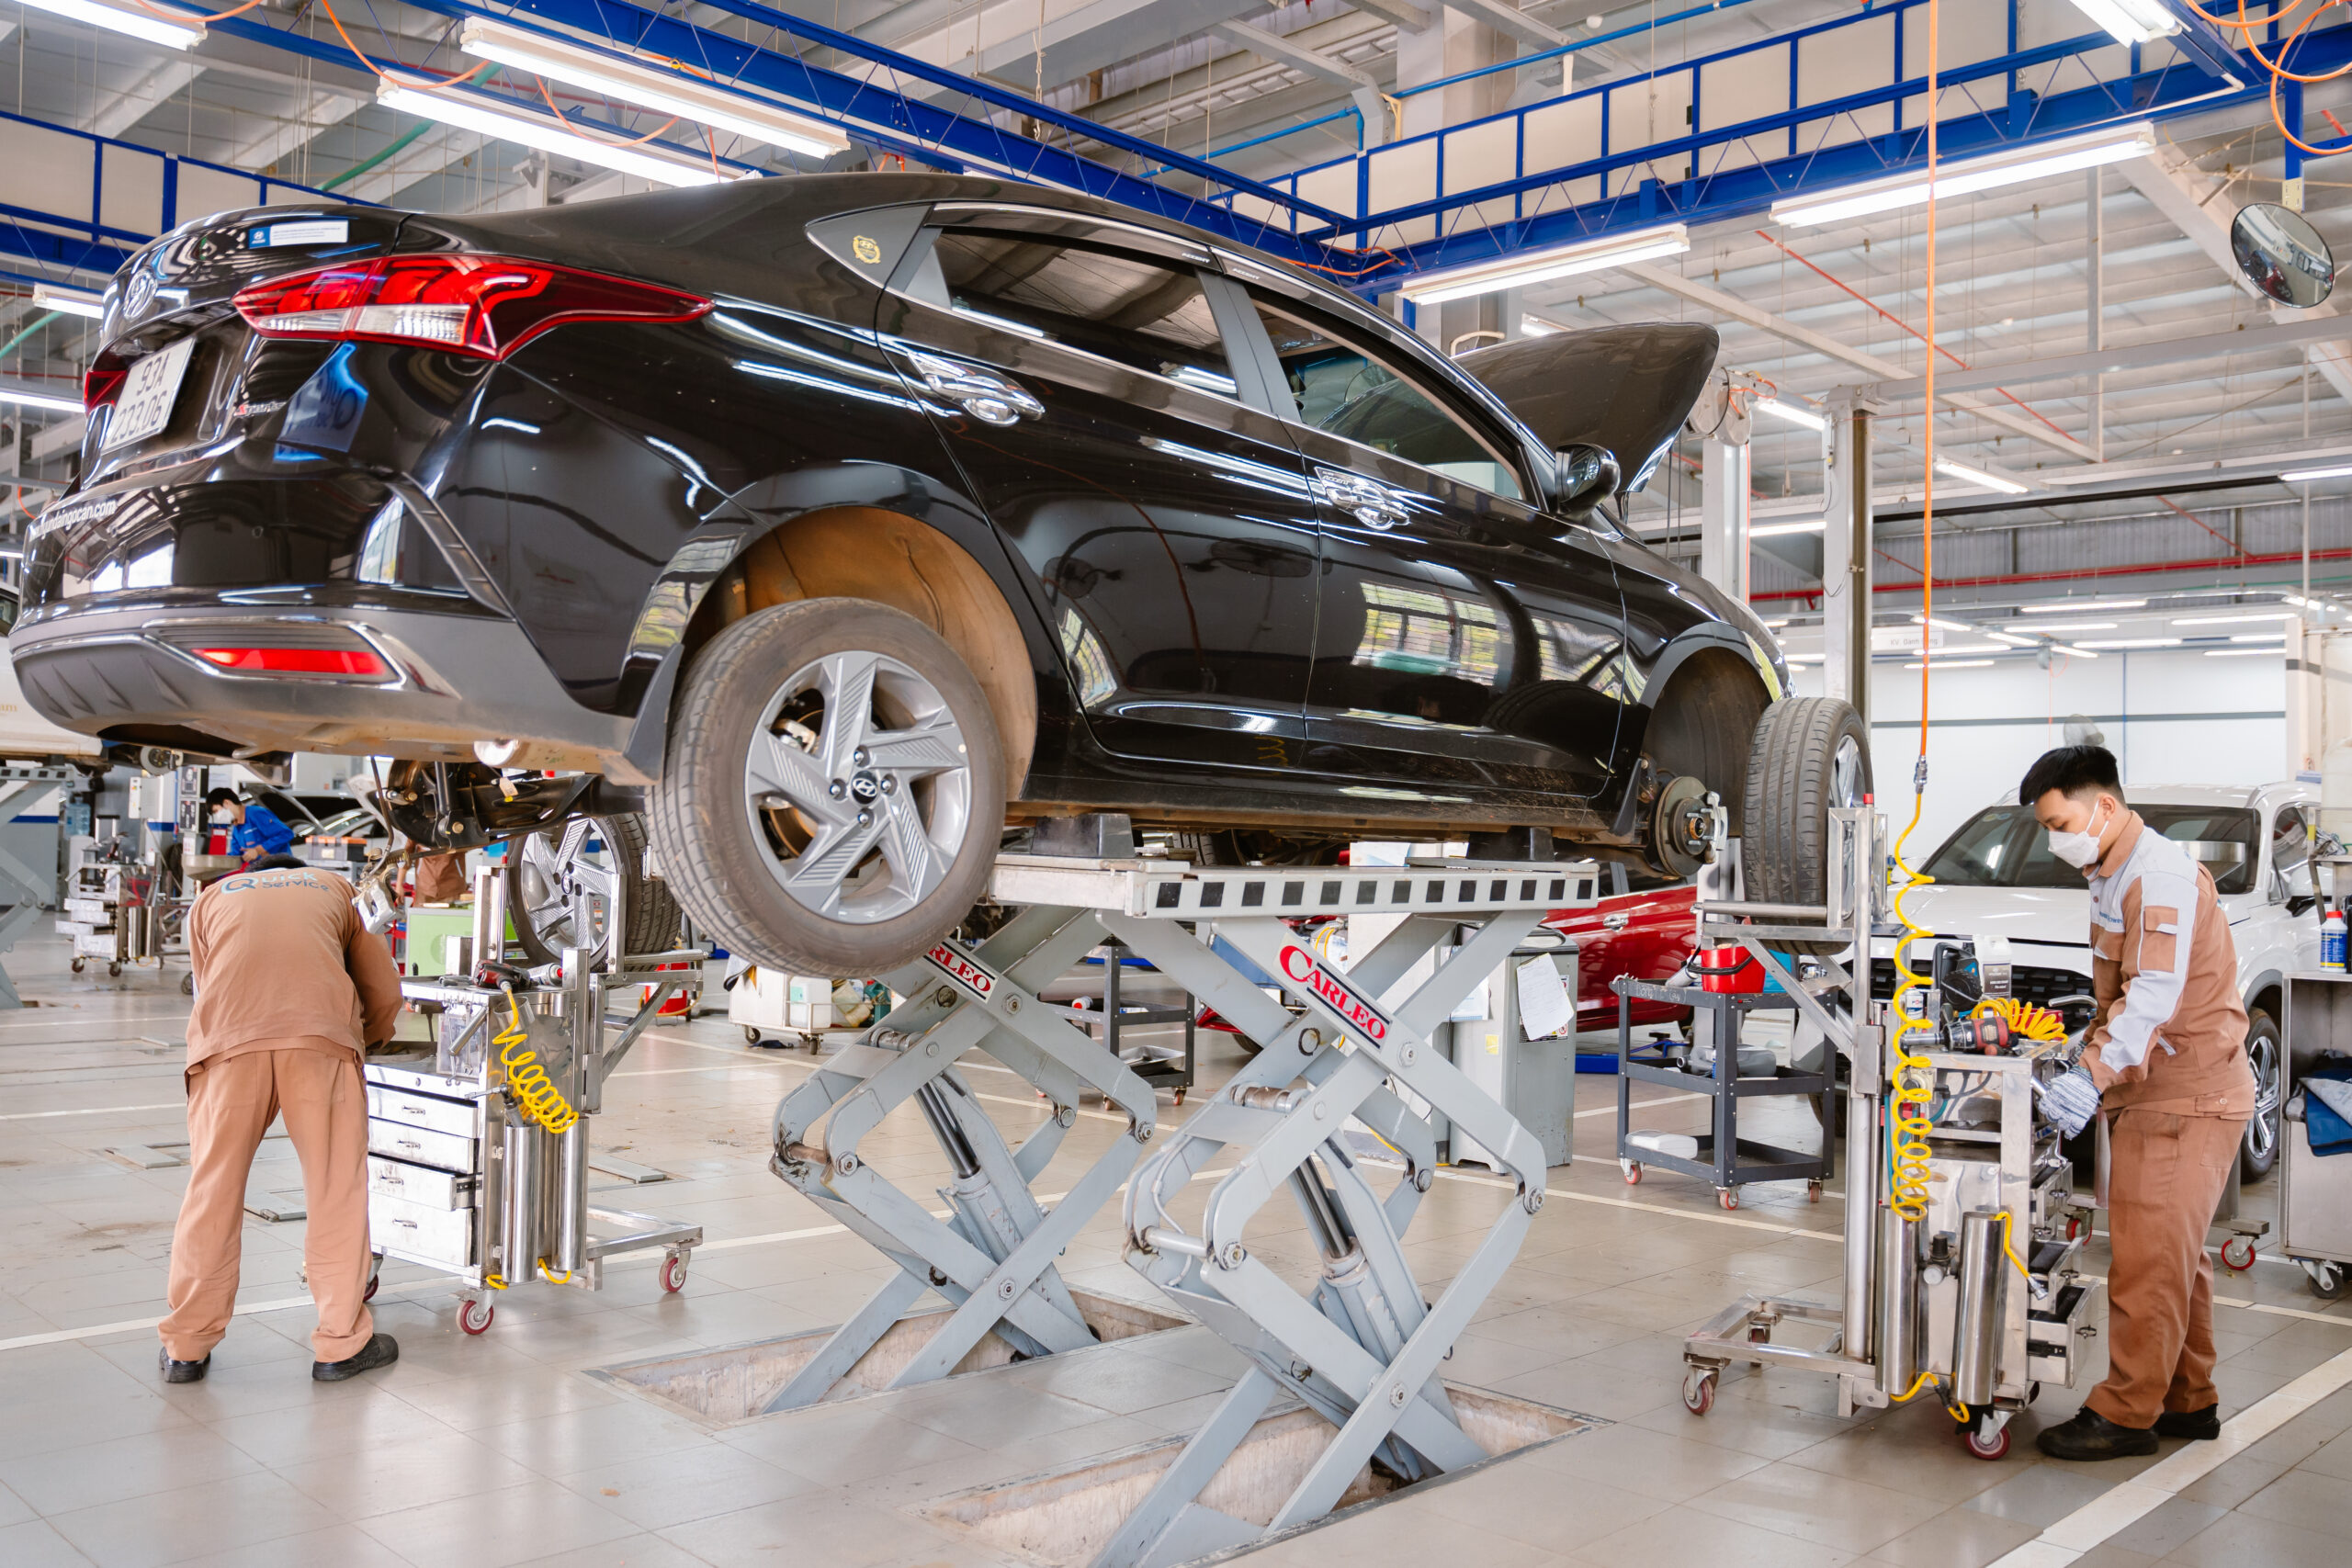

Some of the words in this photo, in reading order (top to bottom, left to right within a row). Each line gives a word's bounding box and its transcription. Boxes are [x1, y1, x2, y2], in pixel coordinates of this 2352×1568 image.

[28, 499, 118, 542] hyundaingocan.com
[928, 944, 991, 992] RLEO
[1279, 945, 1385, 1040] CARLEO
